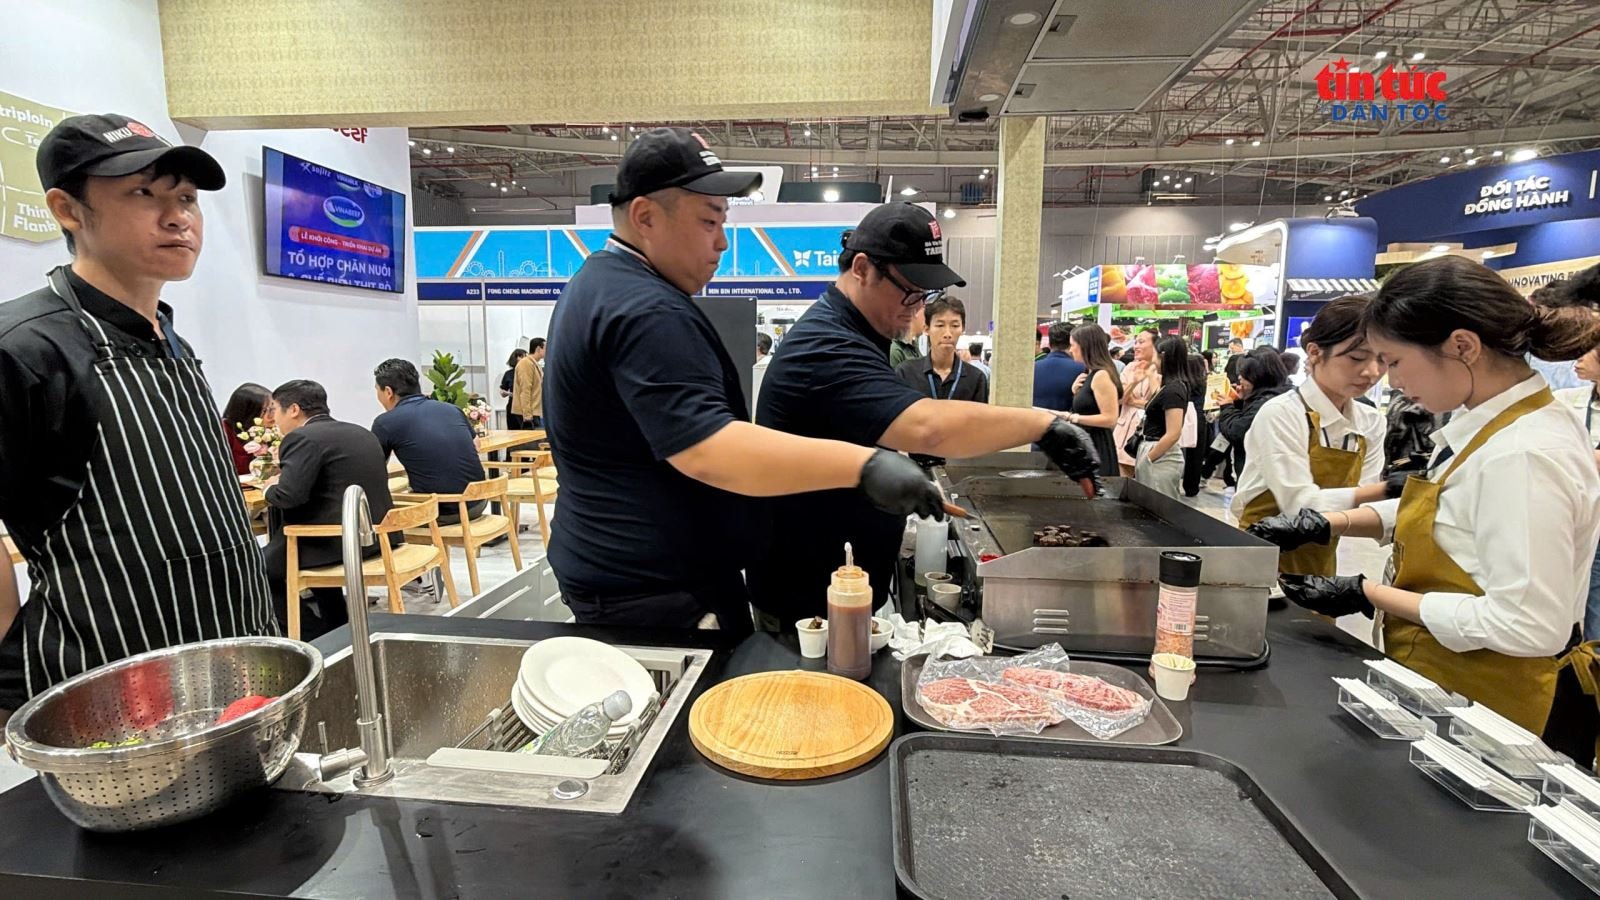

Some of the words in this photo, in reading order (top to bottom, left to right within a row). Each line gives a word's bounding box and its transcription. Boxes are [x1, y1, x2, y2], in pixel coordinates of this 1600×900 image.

[102, 127, 133, 143] NIKU
[1514, 175, 1550, 193] TÁC
[1515, 190, 1569, 208] HÀNH
[17, 203, 49, 218] Thin
[334, 205, 361, 218] VINABEEF
[13, 215, 57, 232] Flank
[813, 249, 840, 267] Tai
[336, 259, 366, 274] CHĂN
[368, 264, 391, 277] NUÔI
